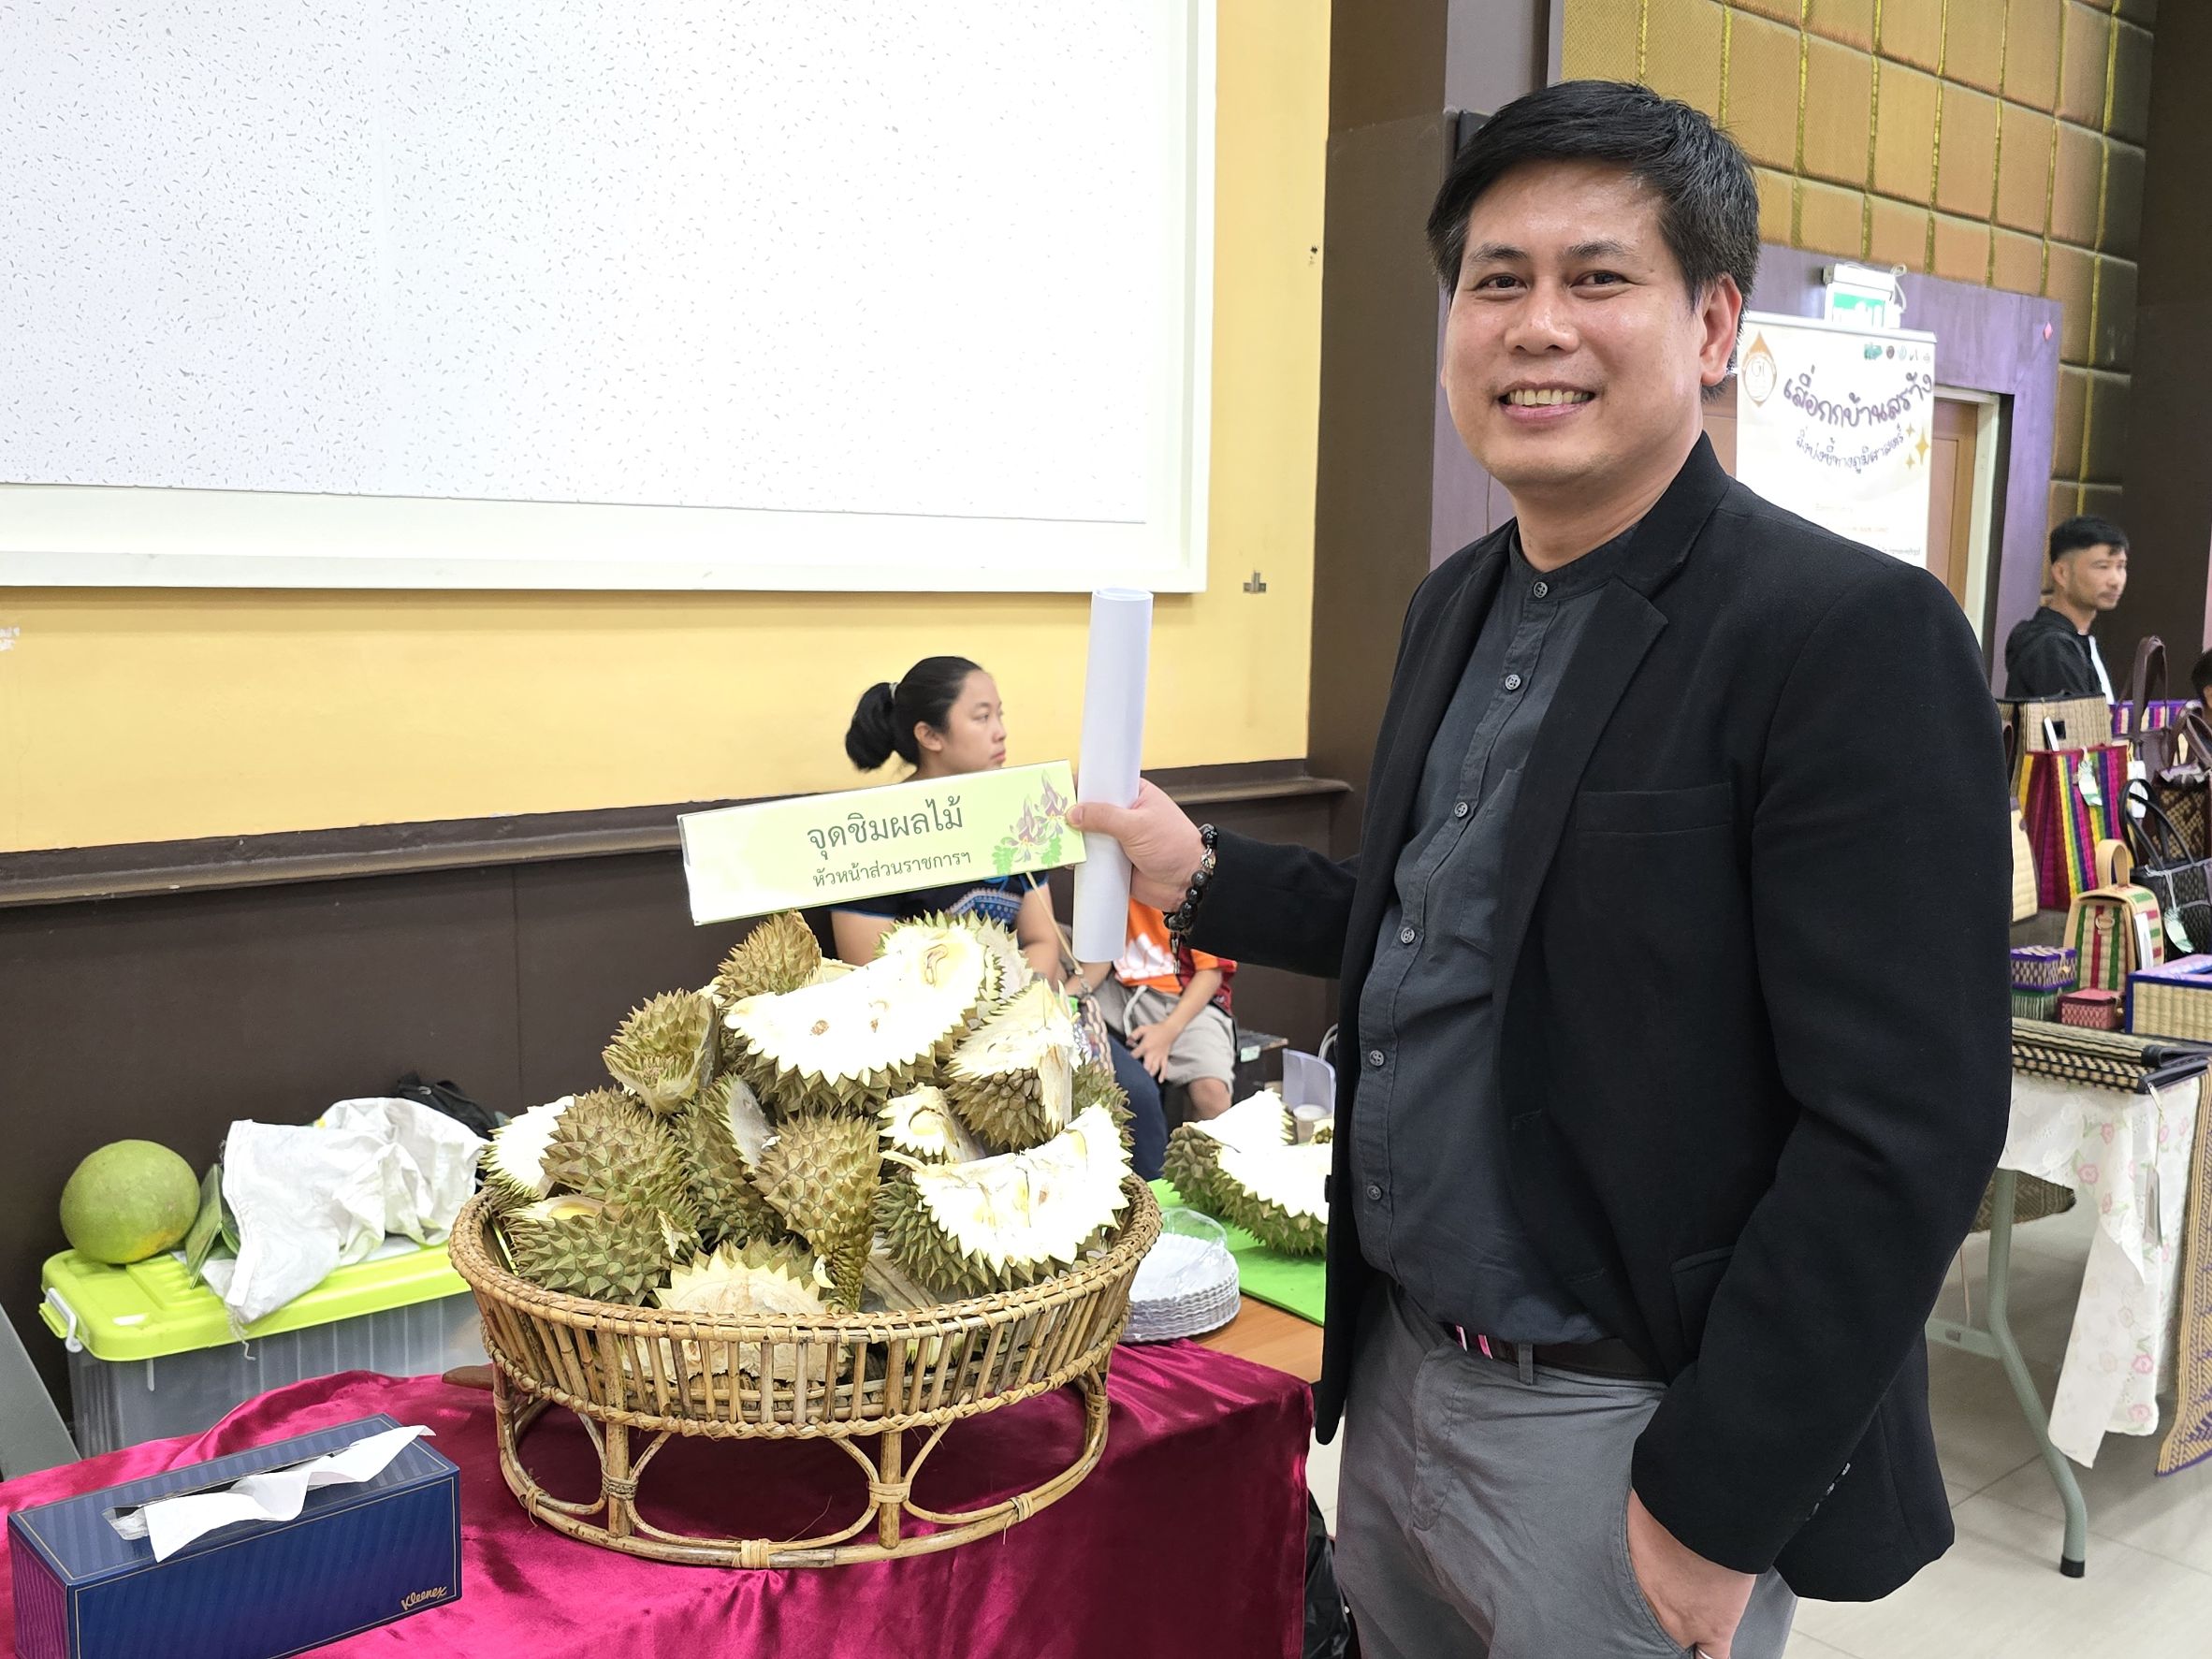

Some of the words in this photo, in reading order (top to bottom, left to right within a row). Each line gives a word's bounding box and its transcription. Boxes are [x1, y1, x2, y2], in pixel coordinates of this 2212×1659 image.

[807, 795, 963, 860] จุดชิมผลไม้
[812, 851, 971, 887] หัวหน้าส่วนราชการฯ
[400, 1586, 447, 1610] Kleenex
